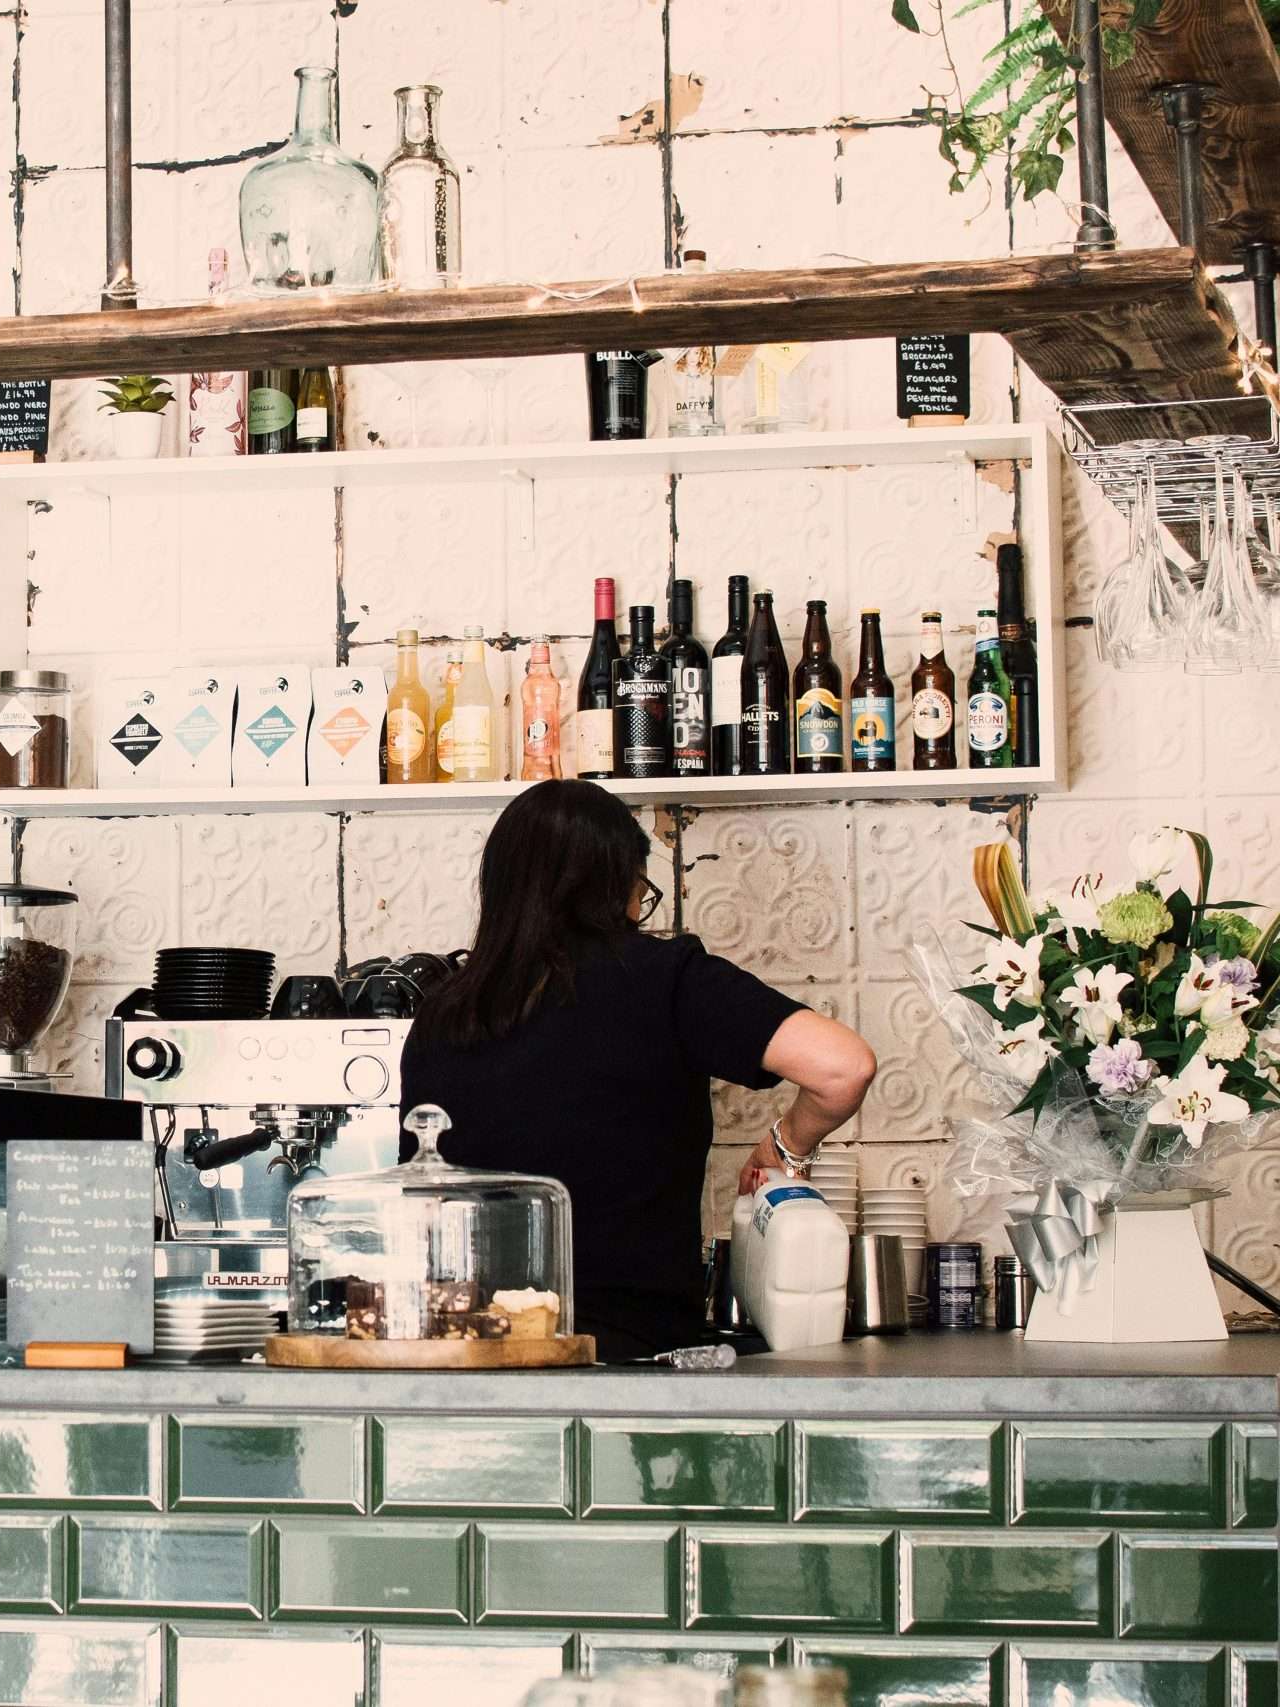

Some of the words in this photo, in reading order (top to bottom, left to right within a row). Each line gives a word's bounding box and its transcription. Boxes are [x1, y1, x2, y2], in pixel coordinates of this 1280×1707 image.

[900, 343, 946, 352] DAFFY'S
[596, 350, 633, 362] BULLD
[902, 352, 954, 361] BROCKMANS
[24, 401, 48, 409] NERO
[676, 401, 713, 411] DAFFY'S
[918, 404, 953, 412] TONIC
[25, 412, 47, 421] PINK
[617, 678, 668, 697] BROCKMANS
[969, 714, 1004, 725] PERONI
[799, 720, 839, 730] SNOWDON
[227, 1275, 289, 1286] MARZO
